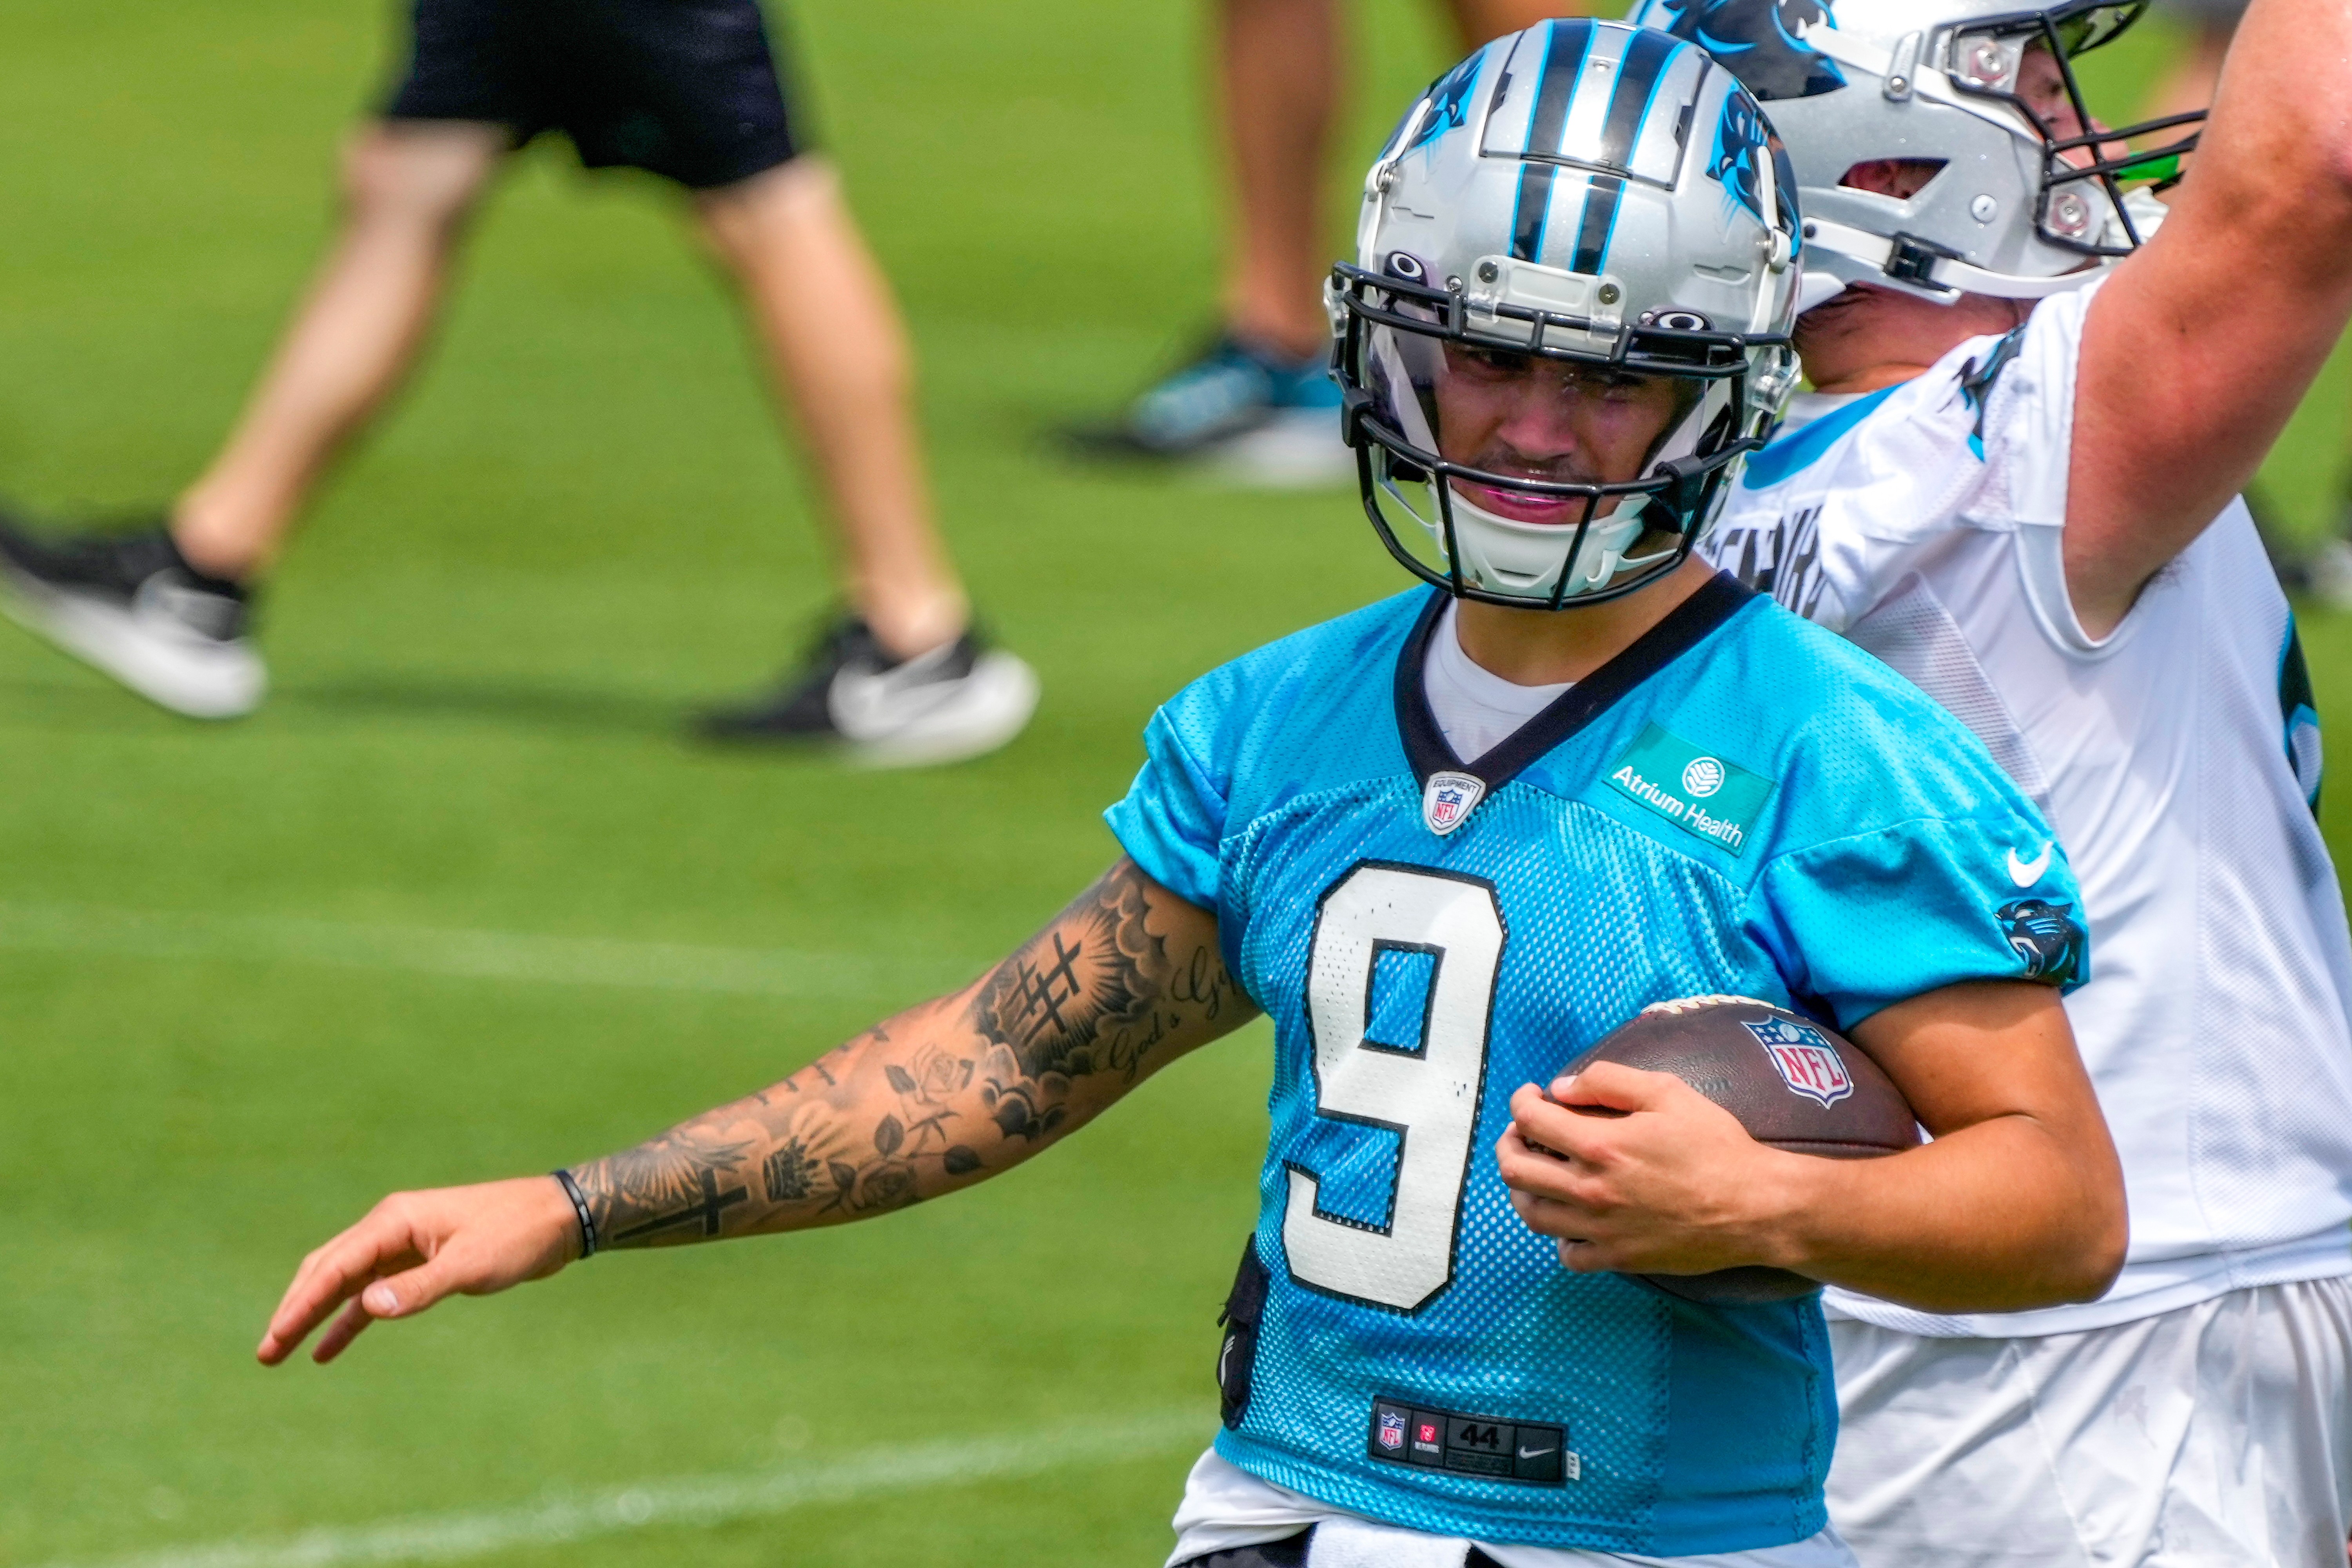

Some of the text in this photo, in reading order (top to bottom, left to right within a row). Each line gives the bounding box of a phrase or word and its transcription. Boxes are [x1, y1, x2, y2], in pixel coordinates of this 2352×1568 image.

[1433, 779, 1477, 793] EQUIPMENT
[1435, 803, 1454, 820] NFL
[1612, 765, 1743, 847] Atrium Health
[1776, 1047, 1844, 1091] NFL
[1283, 858, 1508, 1316] 9
[1383, 1428, 1399, 1445] NFL
[1459, 1423, 1500, 1450] 44
